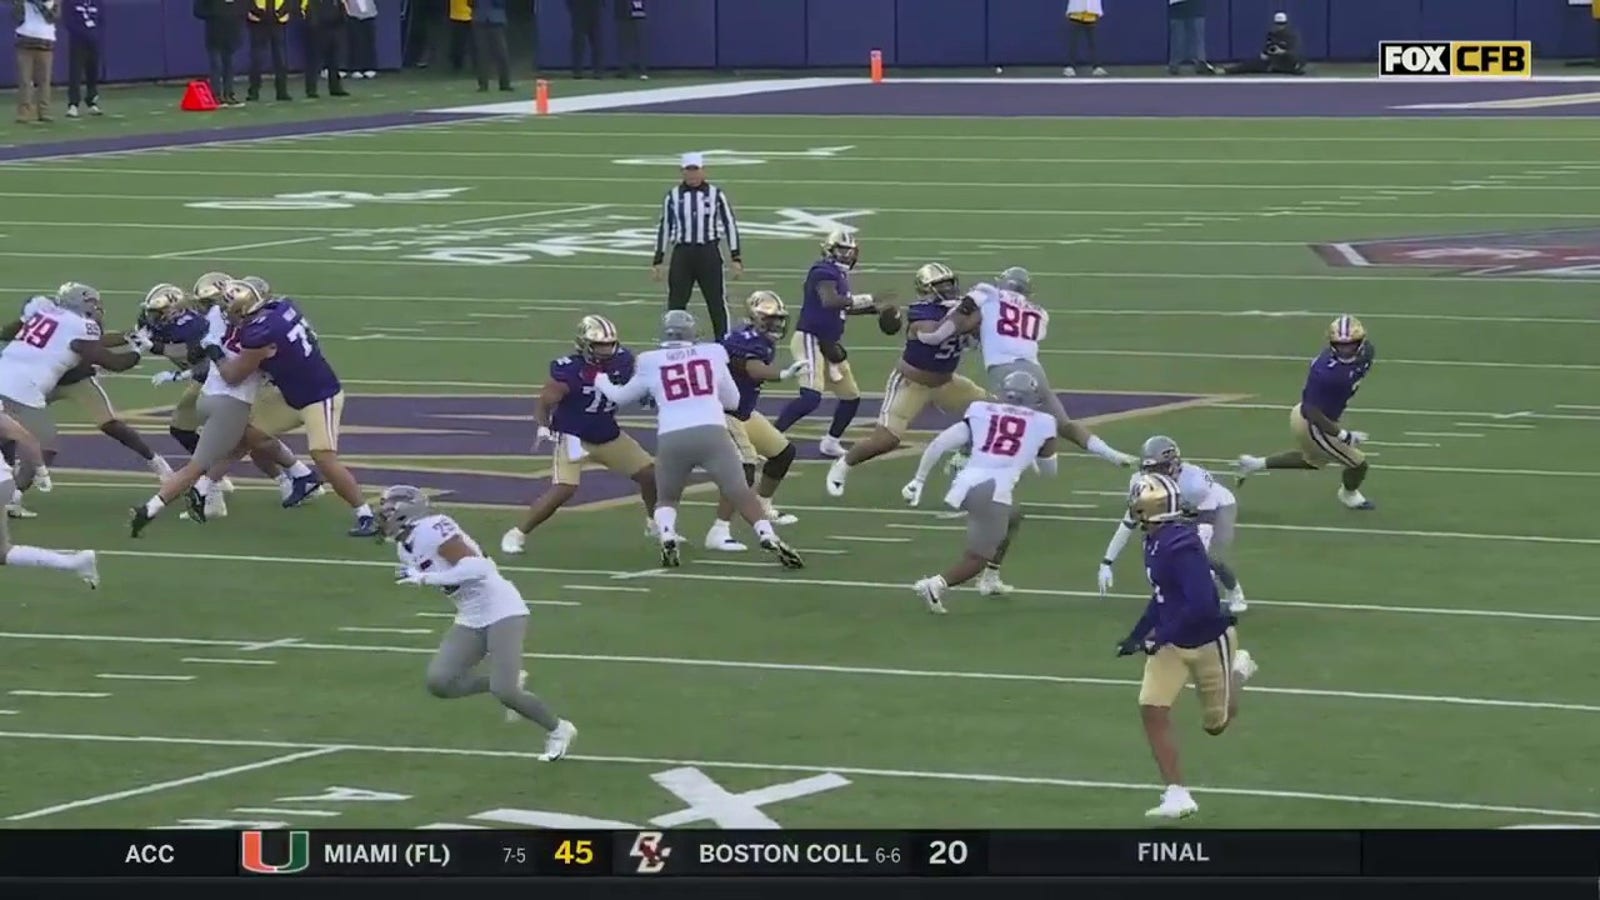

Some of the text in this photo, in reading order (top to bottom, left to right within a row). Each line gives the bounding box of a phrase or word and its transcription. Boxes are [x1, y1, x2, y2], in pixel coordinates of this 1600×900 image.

[997, 301, 1042, 340] 80
[660, 359, 713, 402] 60
[981, 414, 1026, 457] 18
